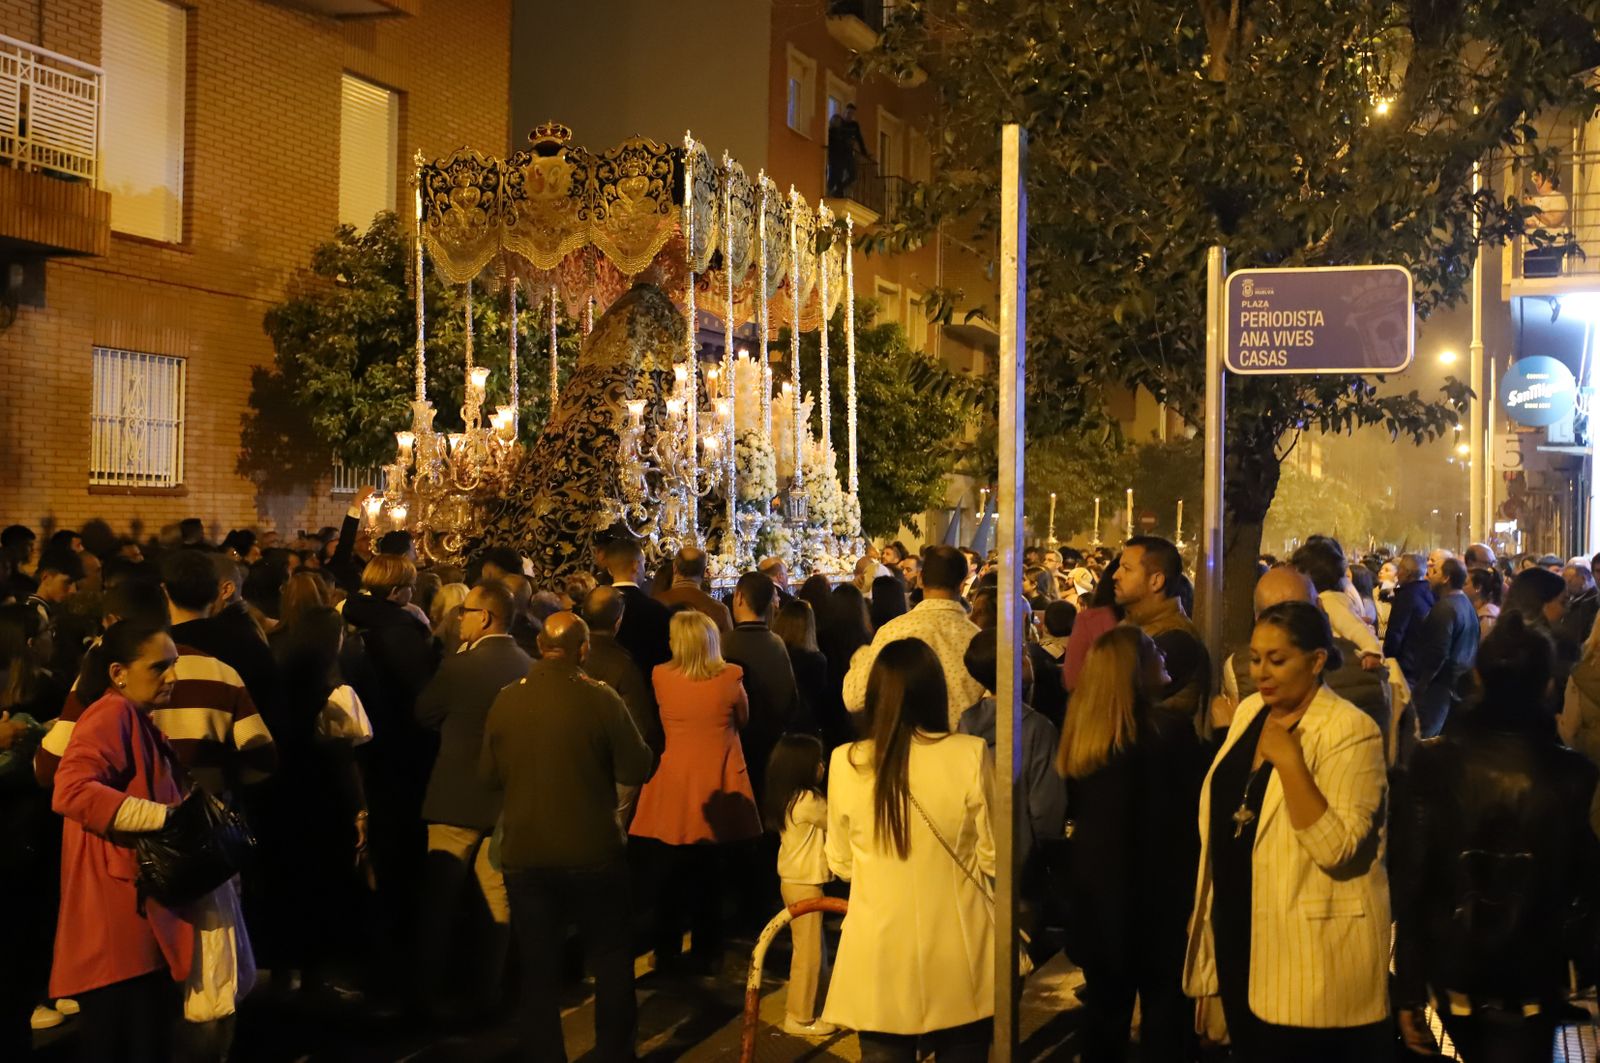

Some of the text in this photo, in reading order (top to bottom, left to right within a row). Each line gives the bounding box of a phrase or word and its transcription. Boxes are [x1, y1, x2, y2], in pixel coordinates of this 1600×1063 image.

[1241, 300, 1270, 308] PLAZA
[1240, 310, 1325, 328] PERIODISTA
[1239, 330, 1314, 347] ANA VIVES
[1239, 350, 1288, 367] CASAS
